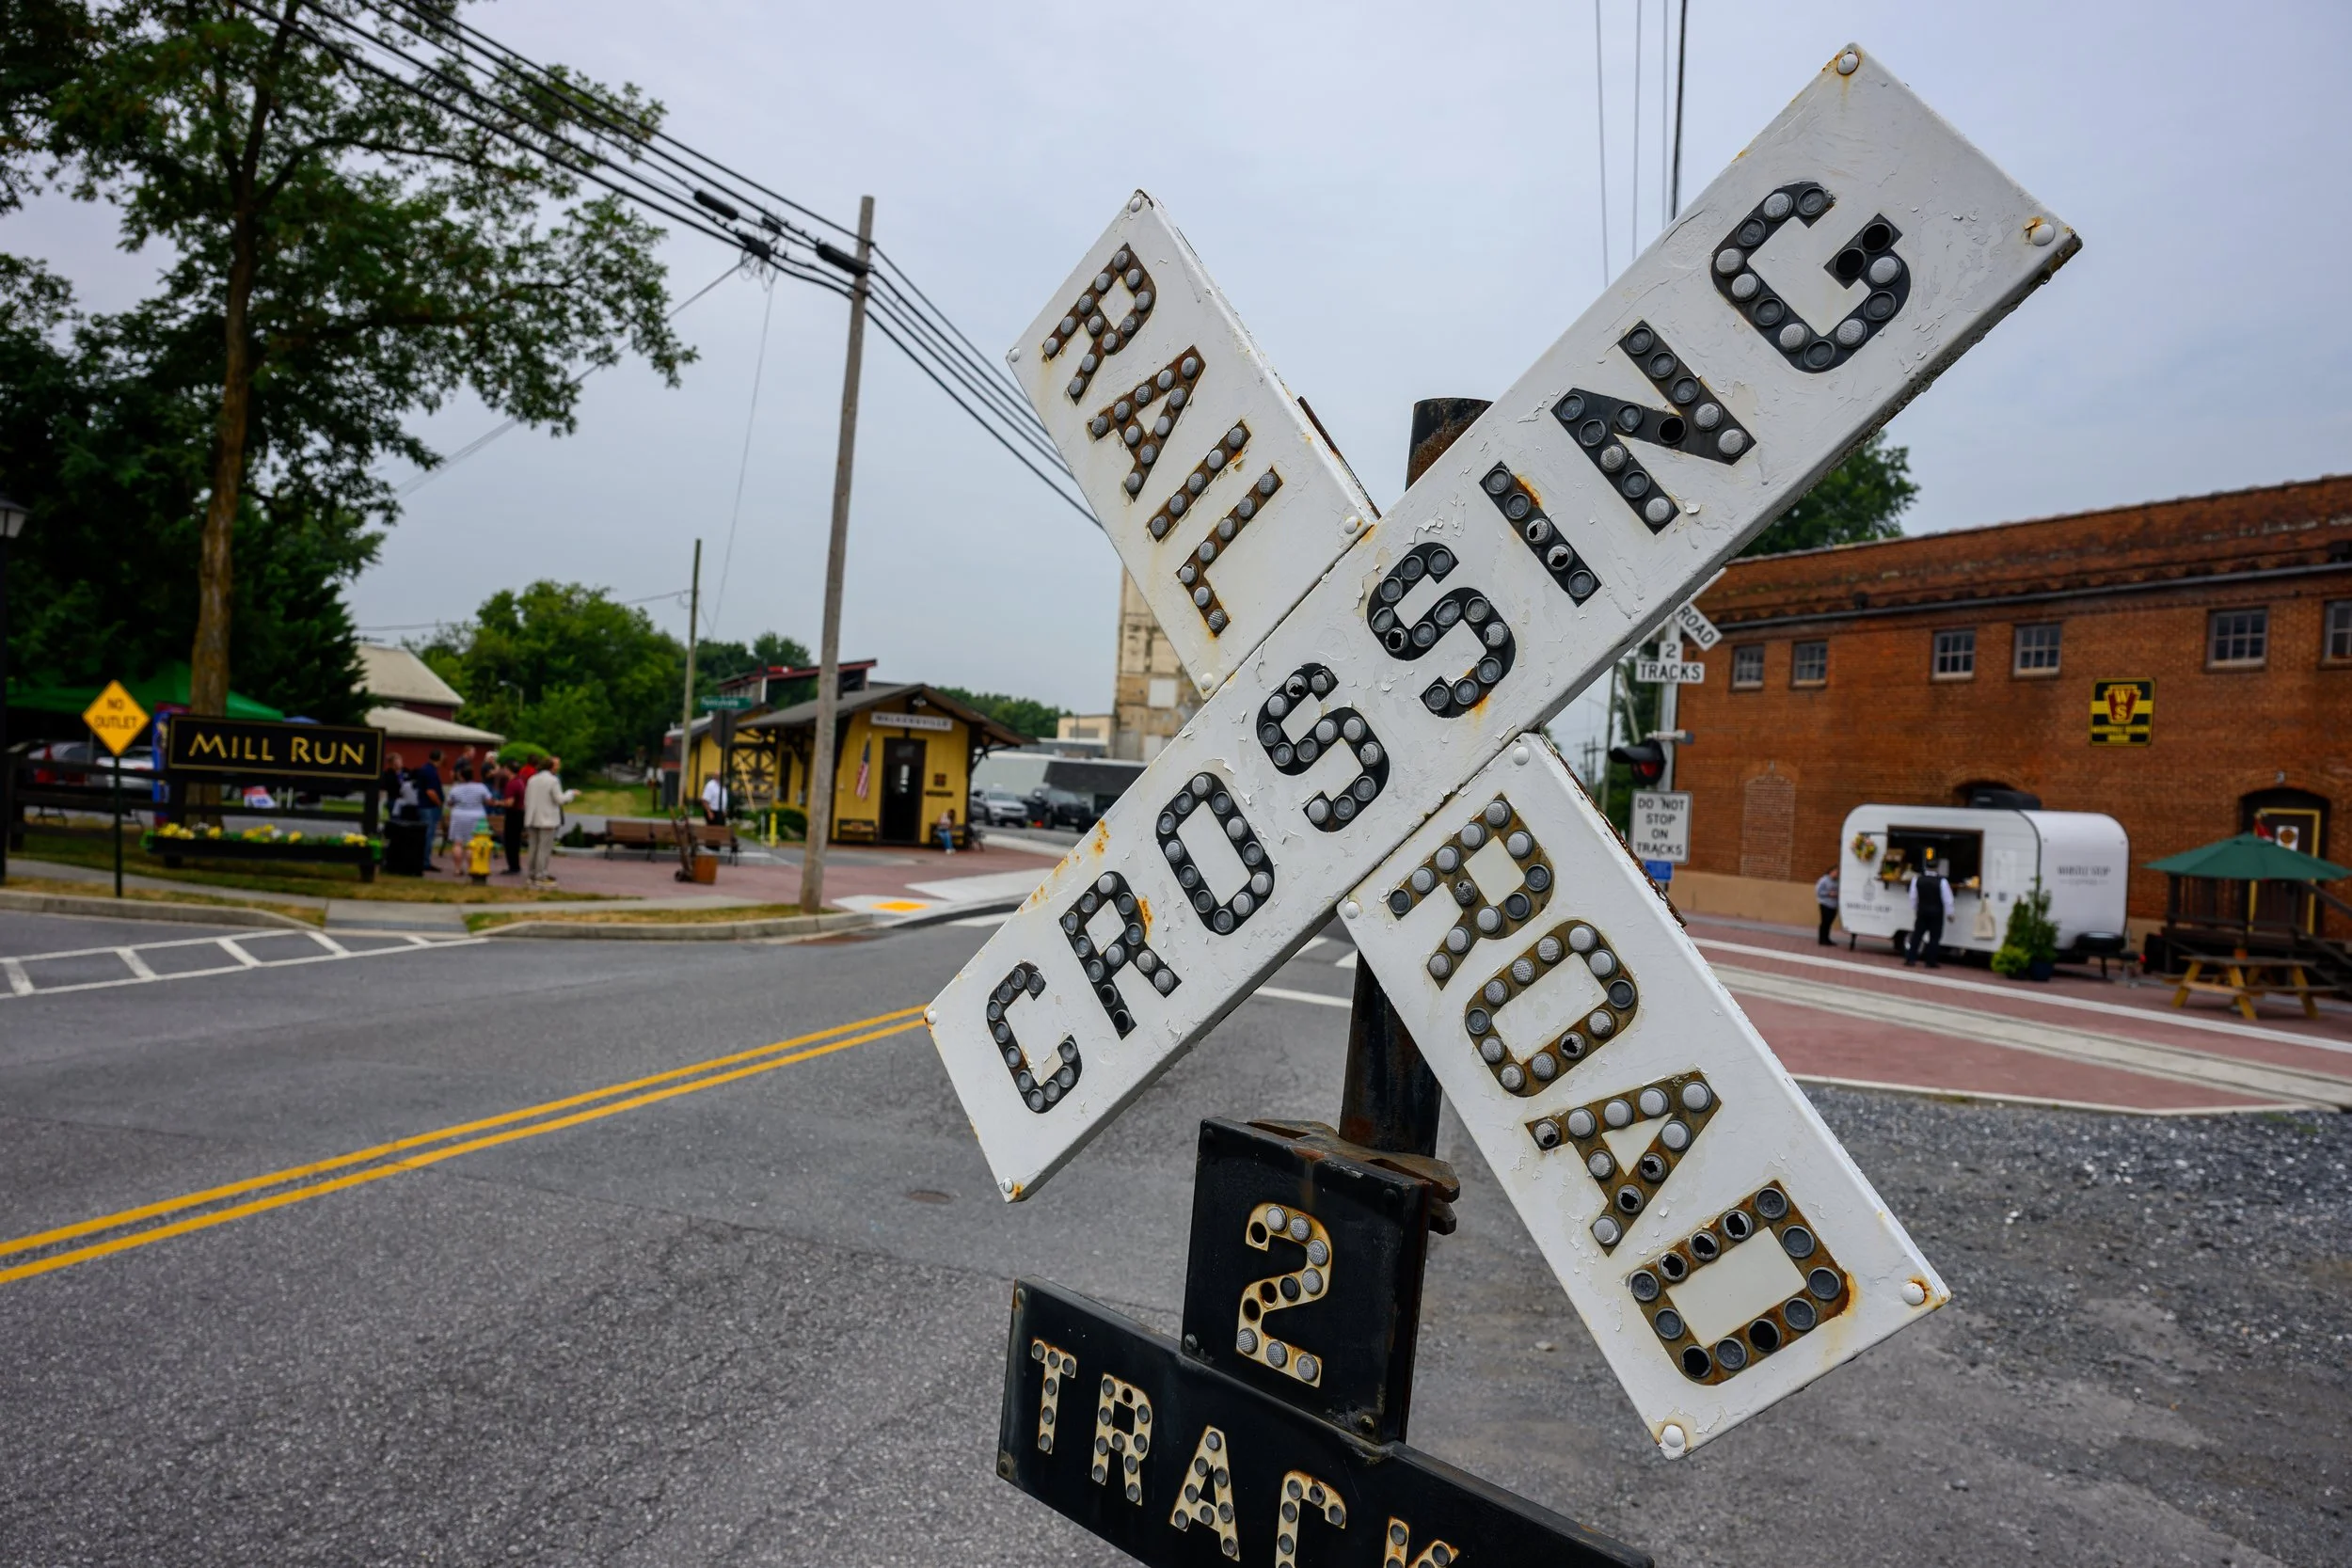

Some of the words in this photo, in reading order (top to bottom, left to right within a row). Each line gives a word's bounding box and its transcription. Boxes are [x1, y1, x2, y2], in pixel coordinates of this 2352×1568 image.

[1042, 243, 1283, 637] RAIL
[1677, 606, 1715, 644] ROAD
[986, 181, 1912, 1113] CROSSING
[1665, 643, 1677, 658] 2
[1641, 663, 1701, 681] TRACKS
[107, 699, 124, 711] NO
[95, 715, 136, 730] OUTLET
[189, 732, 275, 761] MILL
[291, 736, 364, 765] RUN
[1638, 797, 1655, 810] DO
[1661, 798, 1684, 811] NOT
[1646, 813, 1677, 826] STOP
[1651, 829, 1669, 840] ON
[1637, 842, 1683, 857] TRACKS
[1388, 793, 1851, 1386] ROAD
[1235, 1203, 1332, 1387] 2
